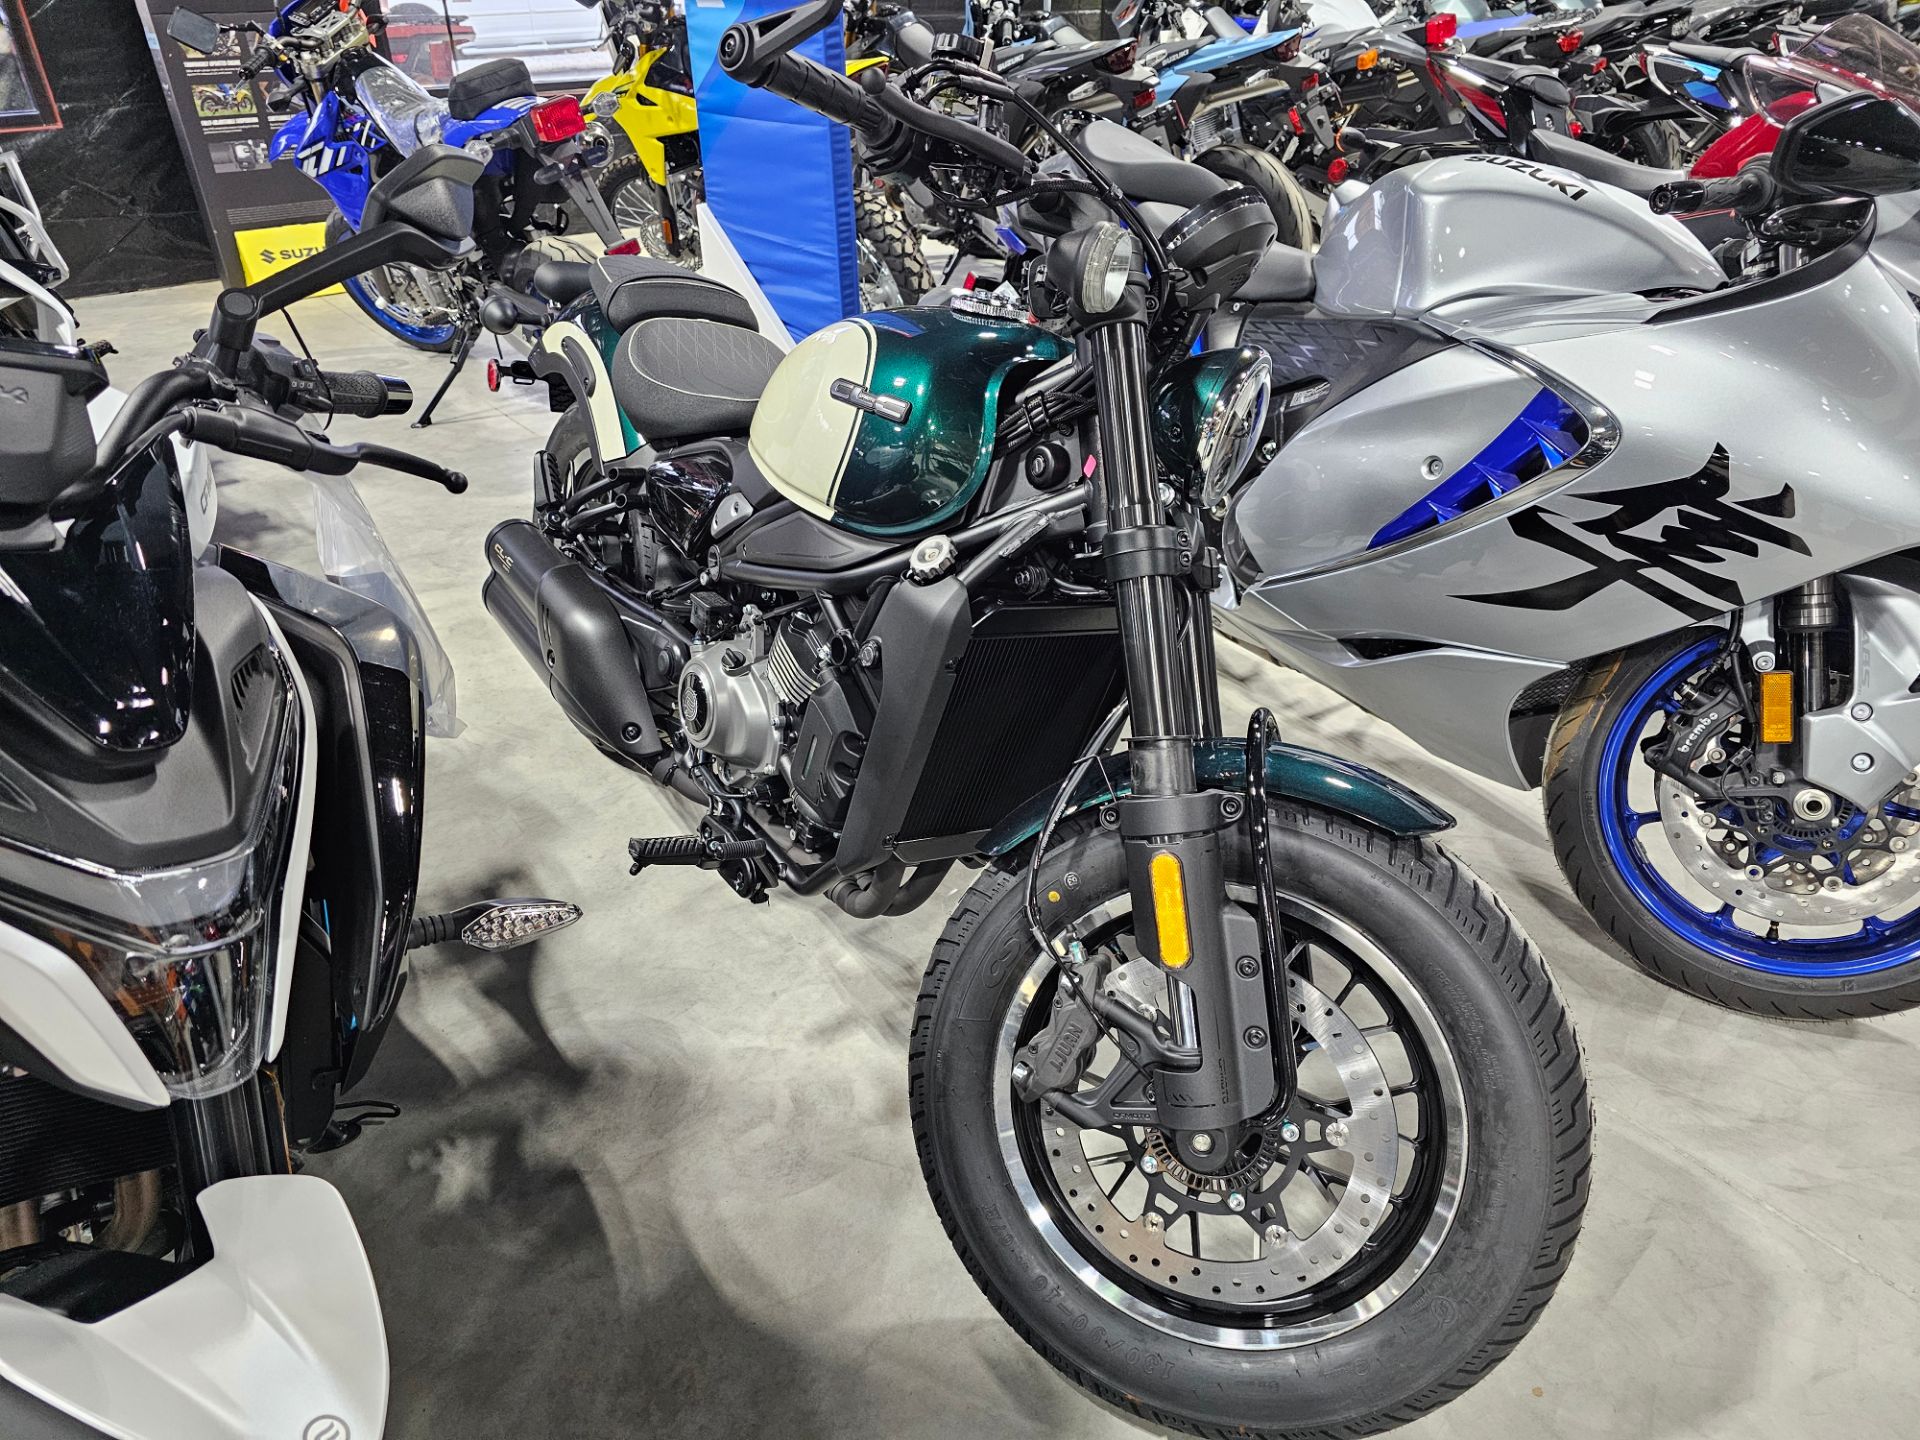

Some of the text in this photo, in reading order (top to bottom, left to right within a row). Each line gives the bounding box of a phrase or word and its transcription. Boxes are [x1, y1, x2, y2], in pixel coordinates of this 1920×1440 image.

[997, 53, 1025, 72] SUZUKI
[1162, 49, 1190, 66] SUZUKI
[1464, 155, 1589, 201] SUZUKI
[279, 246, 327, 260] SUZ
[1860, 629, 1871, 688] ABS
[1677, 712, 1719, 753] brembo
[1049, 1021, 1083, 1073] J.JUAN
[1112, 1111, 1151, 1120] CFMOTO
